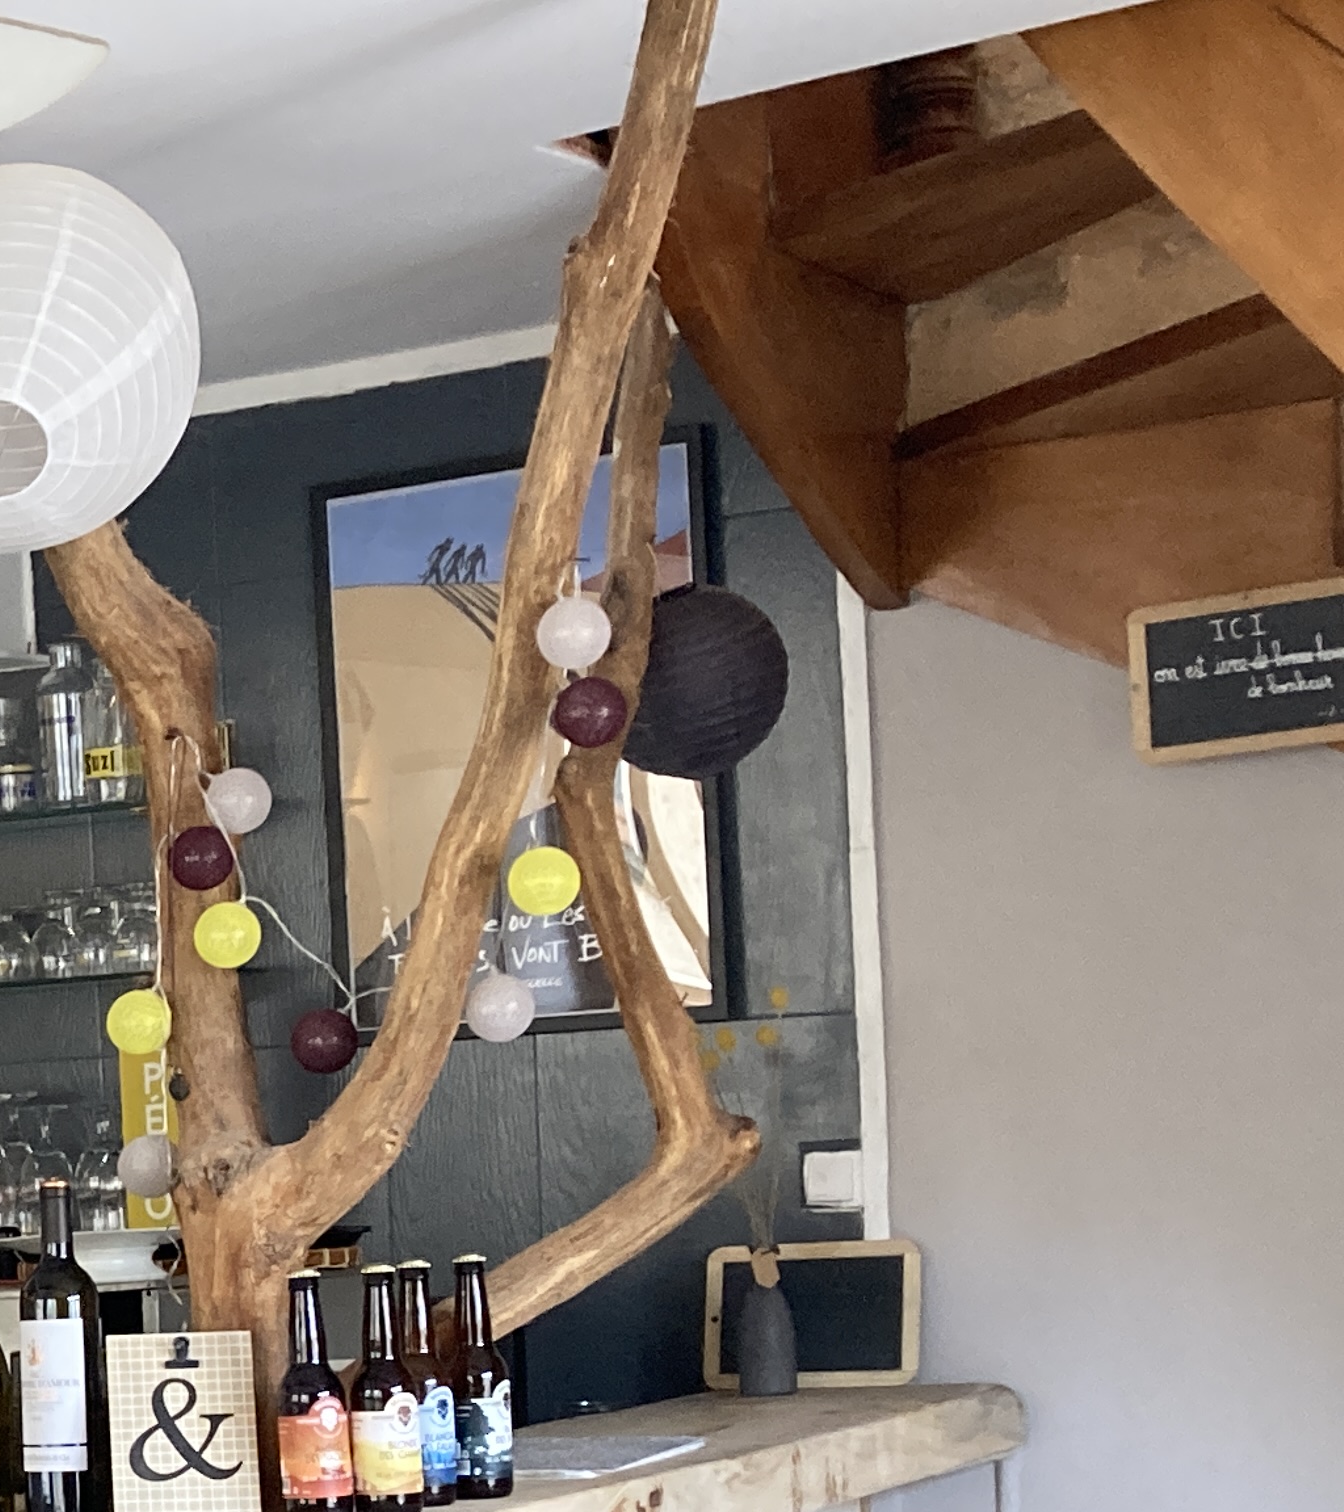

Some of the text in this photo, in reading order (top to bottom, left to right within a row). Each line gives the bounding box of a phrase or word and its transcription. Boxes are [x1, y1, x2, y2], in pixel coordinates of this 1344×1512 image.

[1208, 612, 1267, 642] ICI
[1154, 667, 1180, 683] on
[511, 936, 570, 970] VONT
[129, 1378, 244, 1482] &
